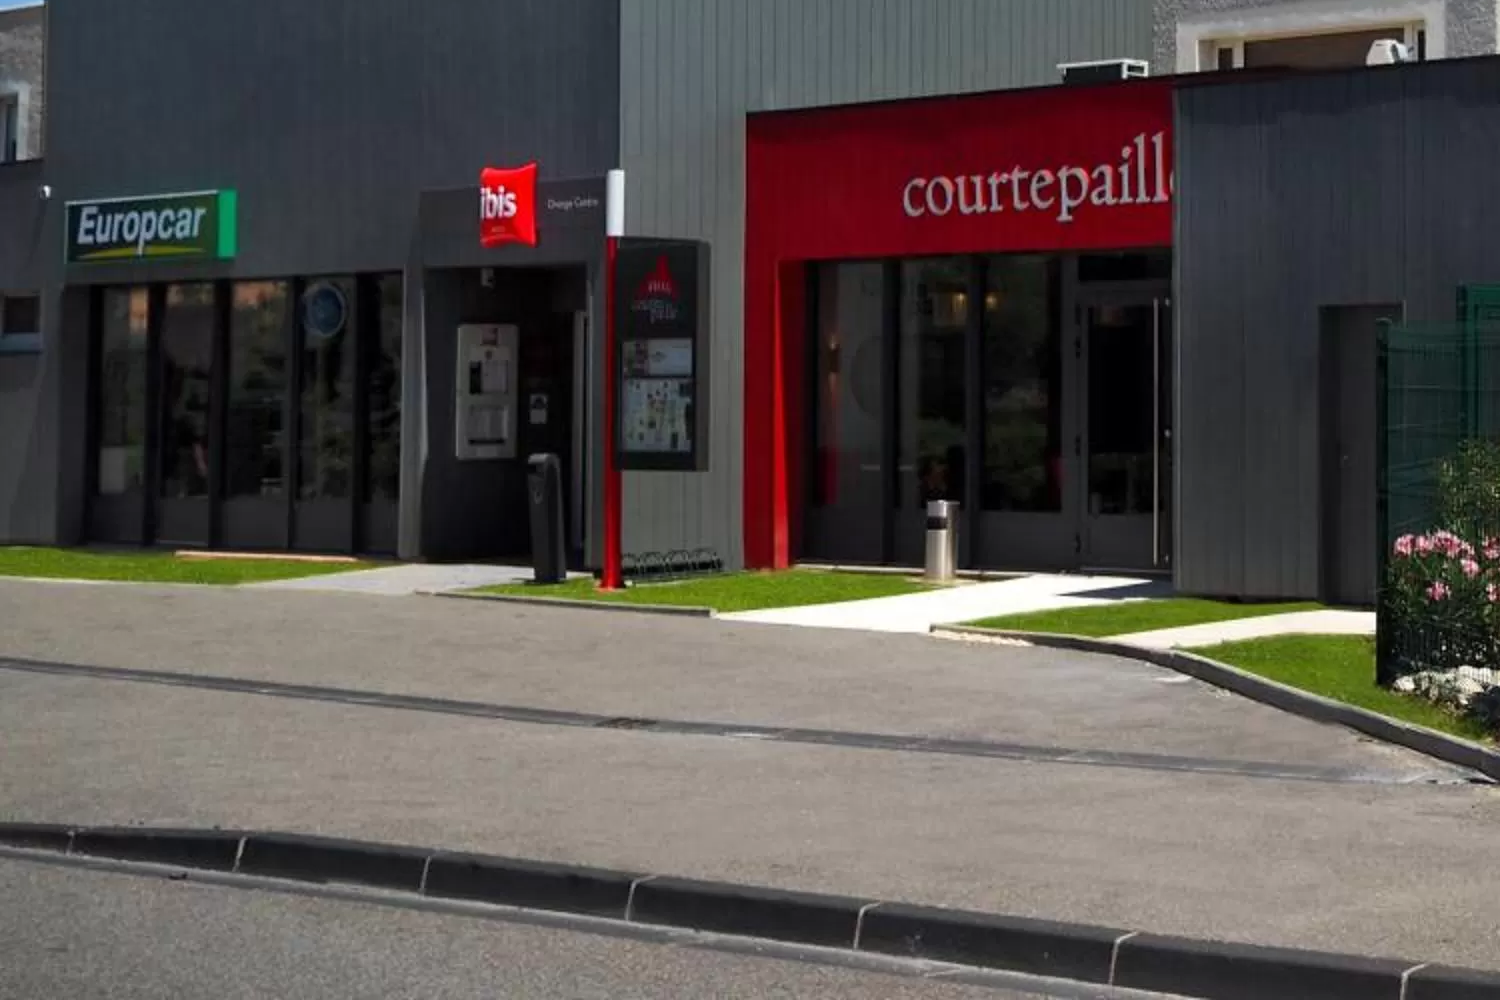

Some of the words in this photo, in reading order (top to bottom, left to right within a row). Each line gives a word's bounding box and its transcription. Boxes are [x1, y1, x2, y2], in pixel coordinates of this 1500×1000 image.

[480, 185, 517, 219] ibis
[902, 131, 1174, 222] courtepaill
[76, 205, 207, 256] Europcar
